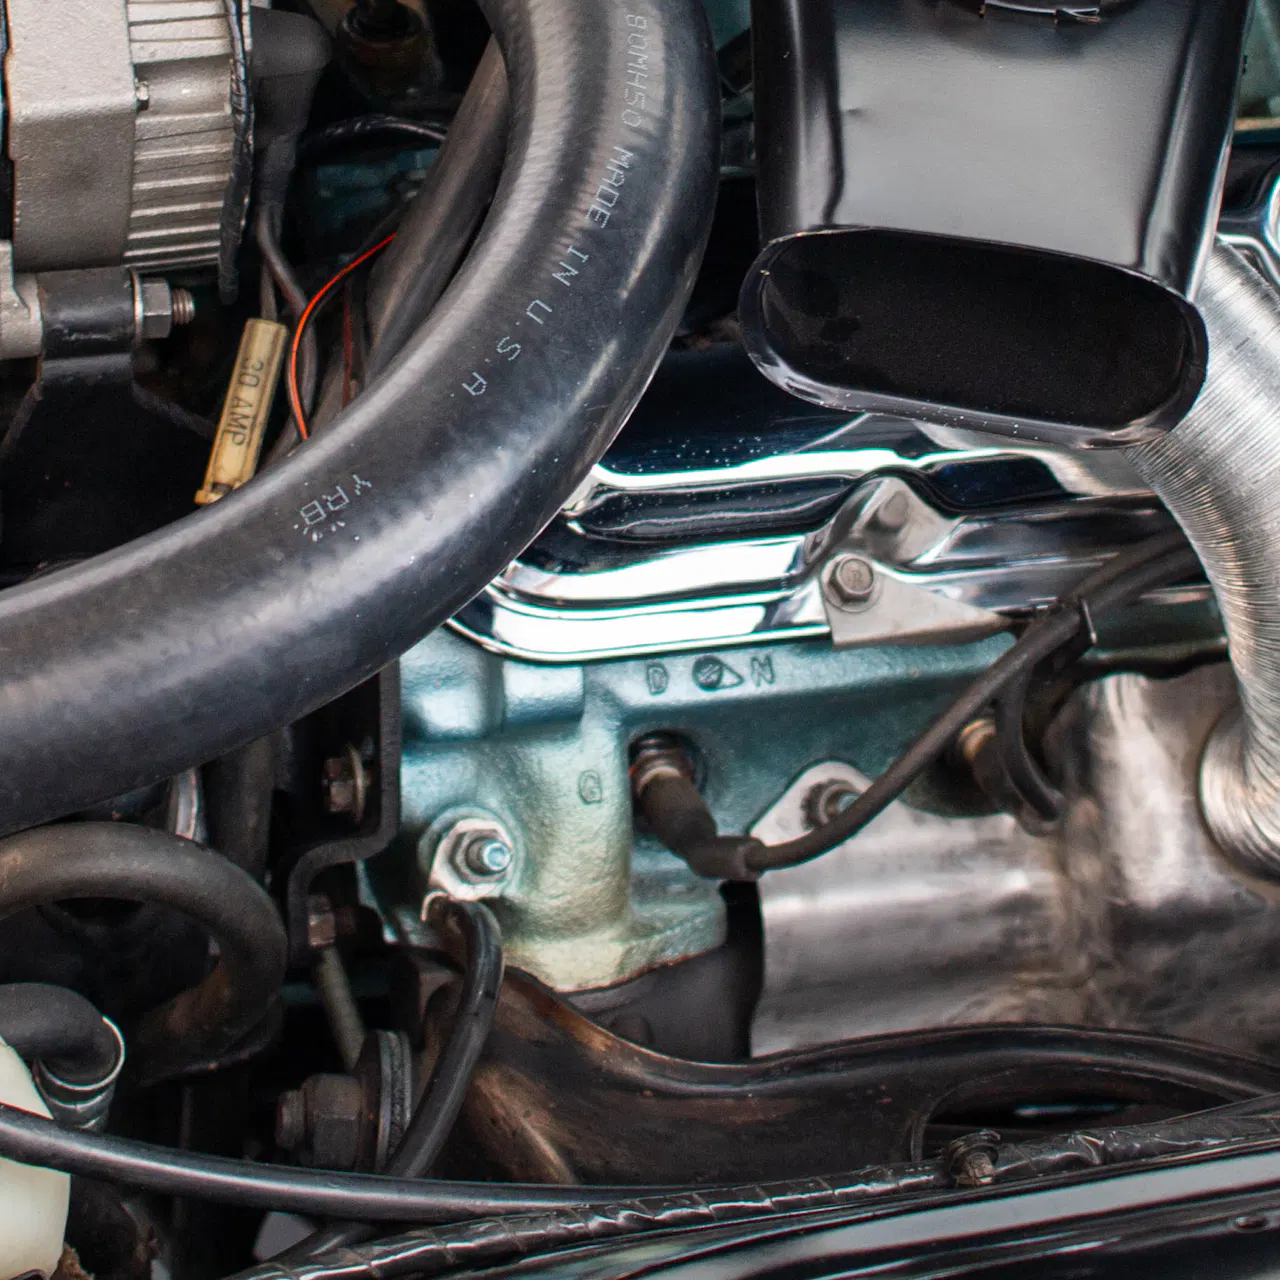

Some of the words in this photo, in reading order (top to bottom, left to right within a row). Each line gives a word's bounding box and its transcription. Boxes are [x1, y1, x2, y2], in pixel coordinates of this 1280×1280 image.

[584, 146, 634, 228] MADE
[551, 245, 589, 287] IN
[238, 358, 264, 388] 30
[222, 396, 253, 447] AMP
